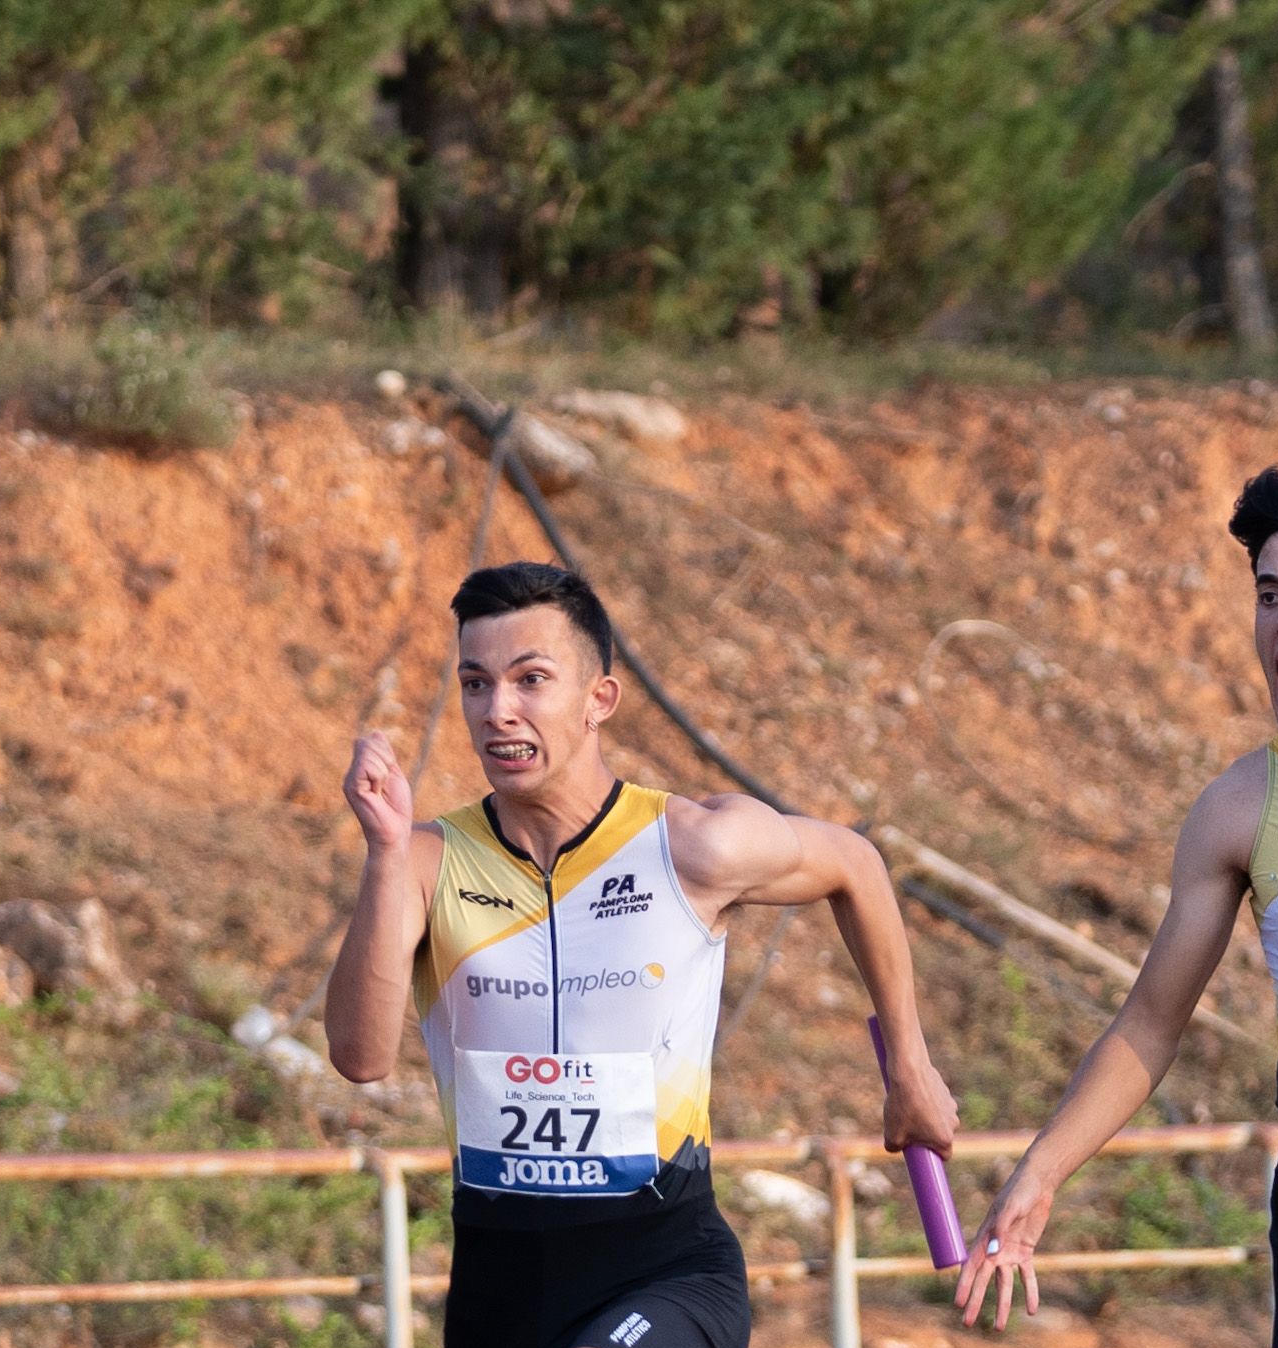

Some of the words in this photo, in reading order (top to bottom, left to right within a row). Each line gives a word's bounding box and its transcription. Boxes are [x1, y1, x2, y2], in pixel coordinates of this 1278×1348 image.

[601, 874, 635, 898] PA
[589, 892, 653, 911] PAMPLONA
[466, 974, 549, 1000] grupo
[500, 1105, 601, 1152] 247
